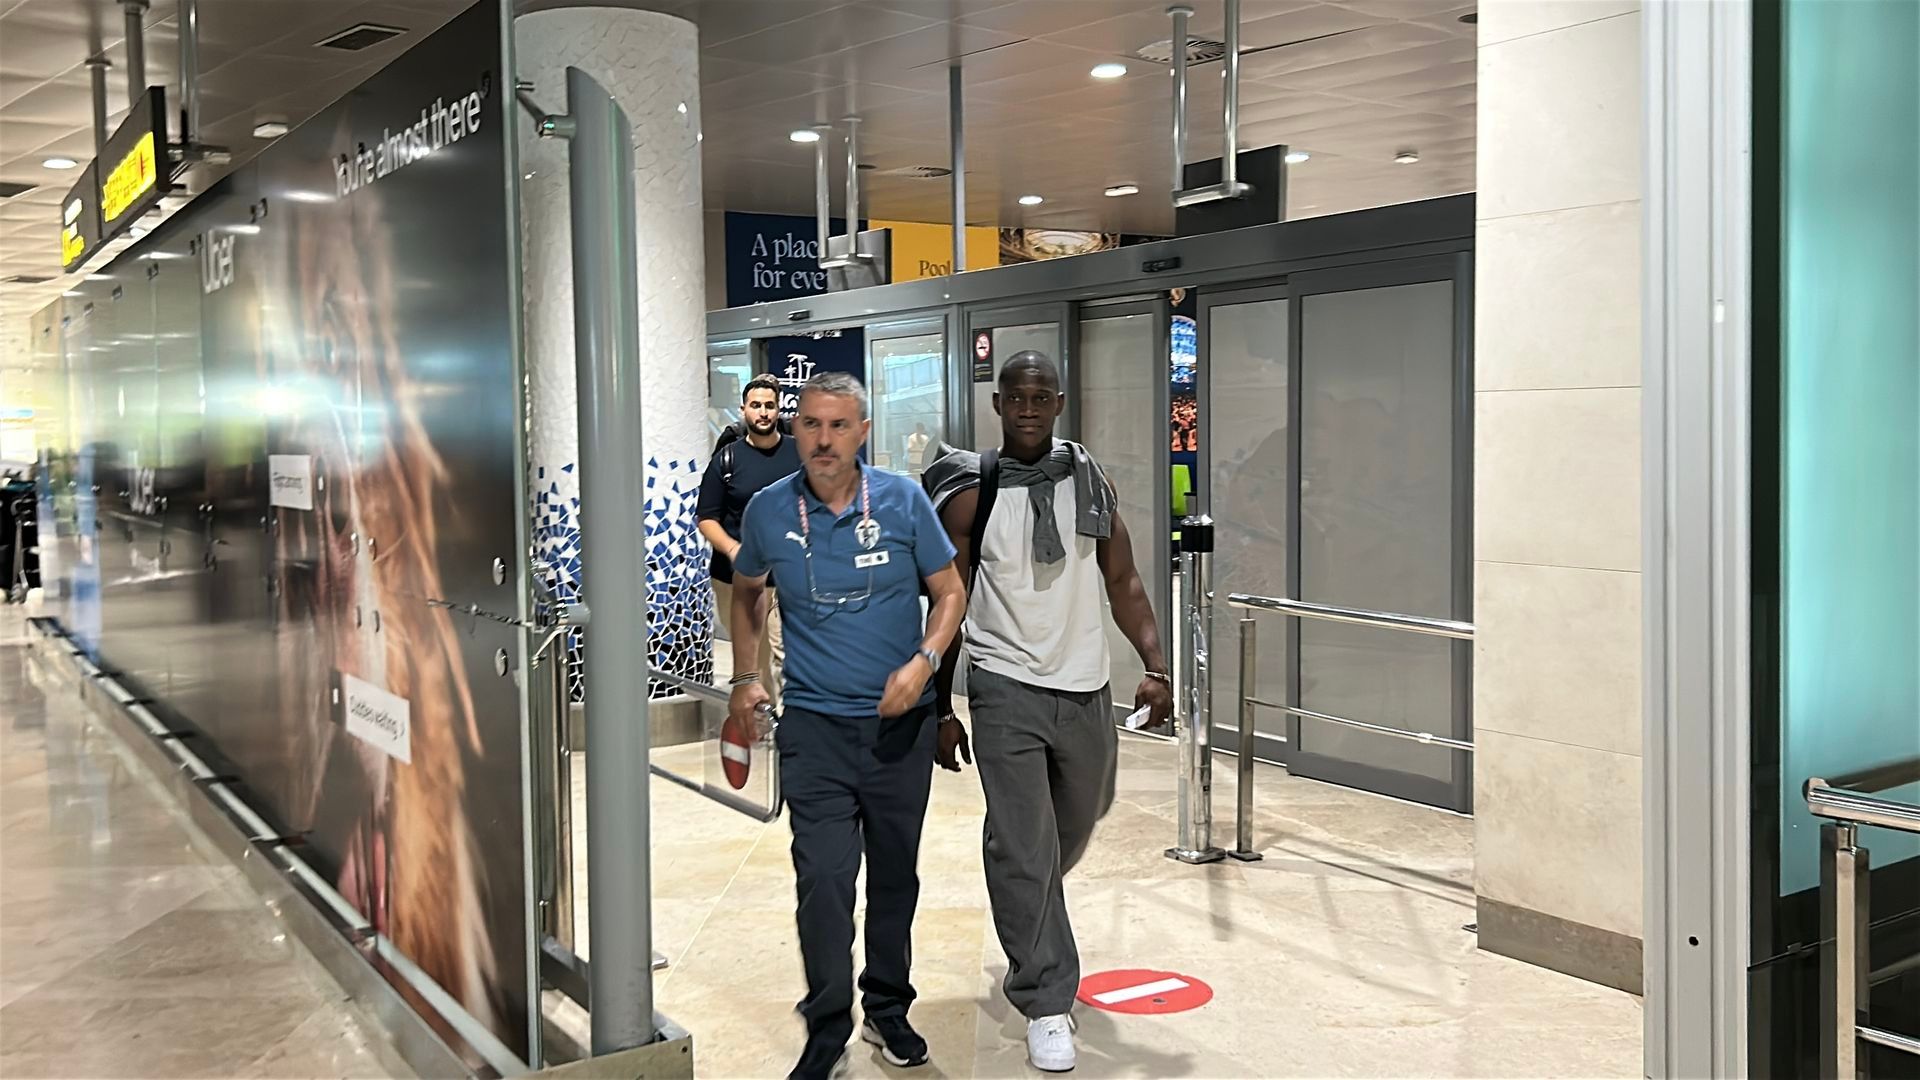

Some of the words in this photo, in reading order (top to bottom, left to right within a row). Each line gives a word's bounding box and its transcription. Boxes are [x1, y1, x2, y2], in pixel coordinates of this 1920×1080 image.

[376, 108, 430, 178] almost
[431, 96, 481, 150] there
[751, 233, 768, 257] A
[772, 232, 818, 265] plac
[753, 262, 786, 289] for
[920, 260, 951, 277] Pool
